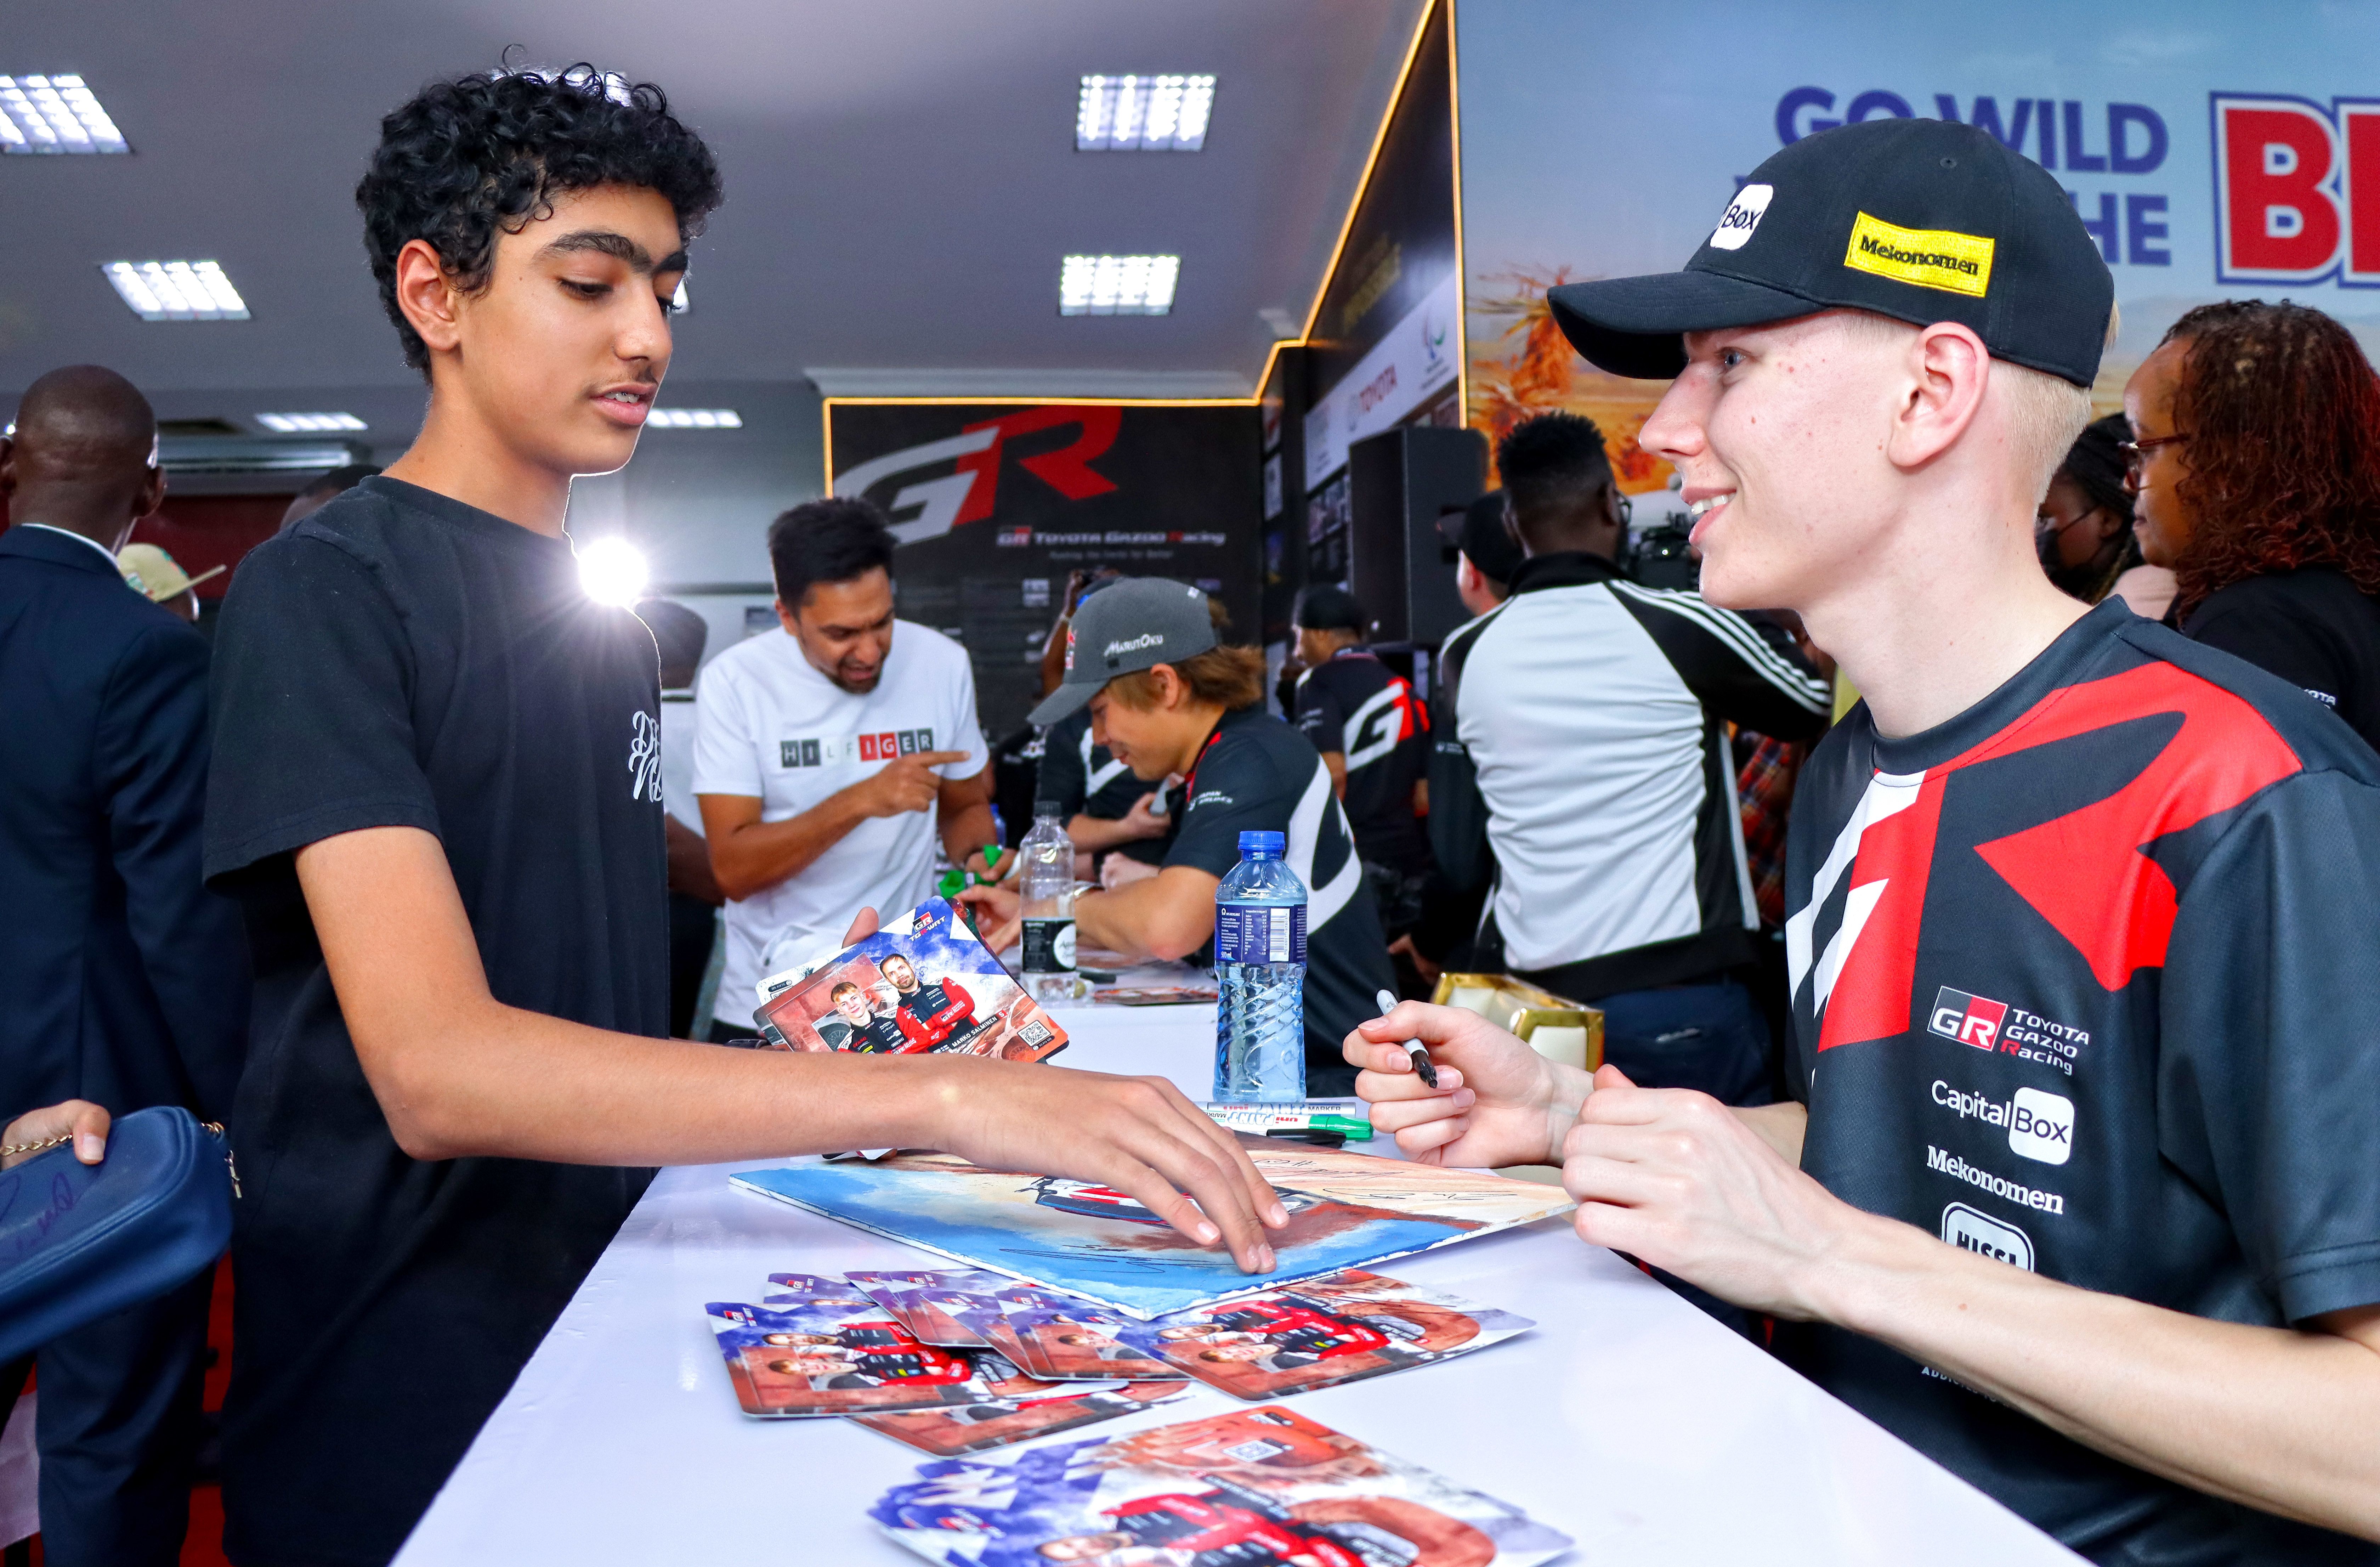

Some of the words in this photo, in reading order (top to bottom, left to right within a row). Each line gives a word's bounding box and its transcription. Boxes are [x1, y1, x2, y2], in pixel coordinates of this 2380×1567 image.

[2209, 91, 2380, 290] B
[1721, 204, 1763, 231] Box
[1859, 235, 1980, 276] Mekonomen
[1034, 532, 1101, 545] TOYOTA
[908, 916, 946, 941] TGR-WRT
[914, 916, 933, 930] GR
[952, 1033, 971, 1047] MARKO
[971, 1016, 998, 1036] SALMINEN
[1932, 1007, 1996, 1050] GR
[2005, 1025, 2078, 1059] GAZOO
[2012, 1007, 2091, 1045] TOYOTA
[2000, 1039, 2073, 1076] Racing
[1227, 1111, 1276, 1126] PAINT
[1927, 1145, 2064, 1216] Mekonomen
